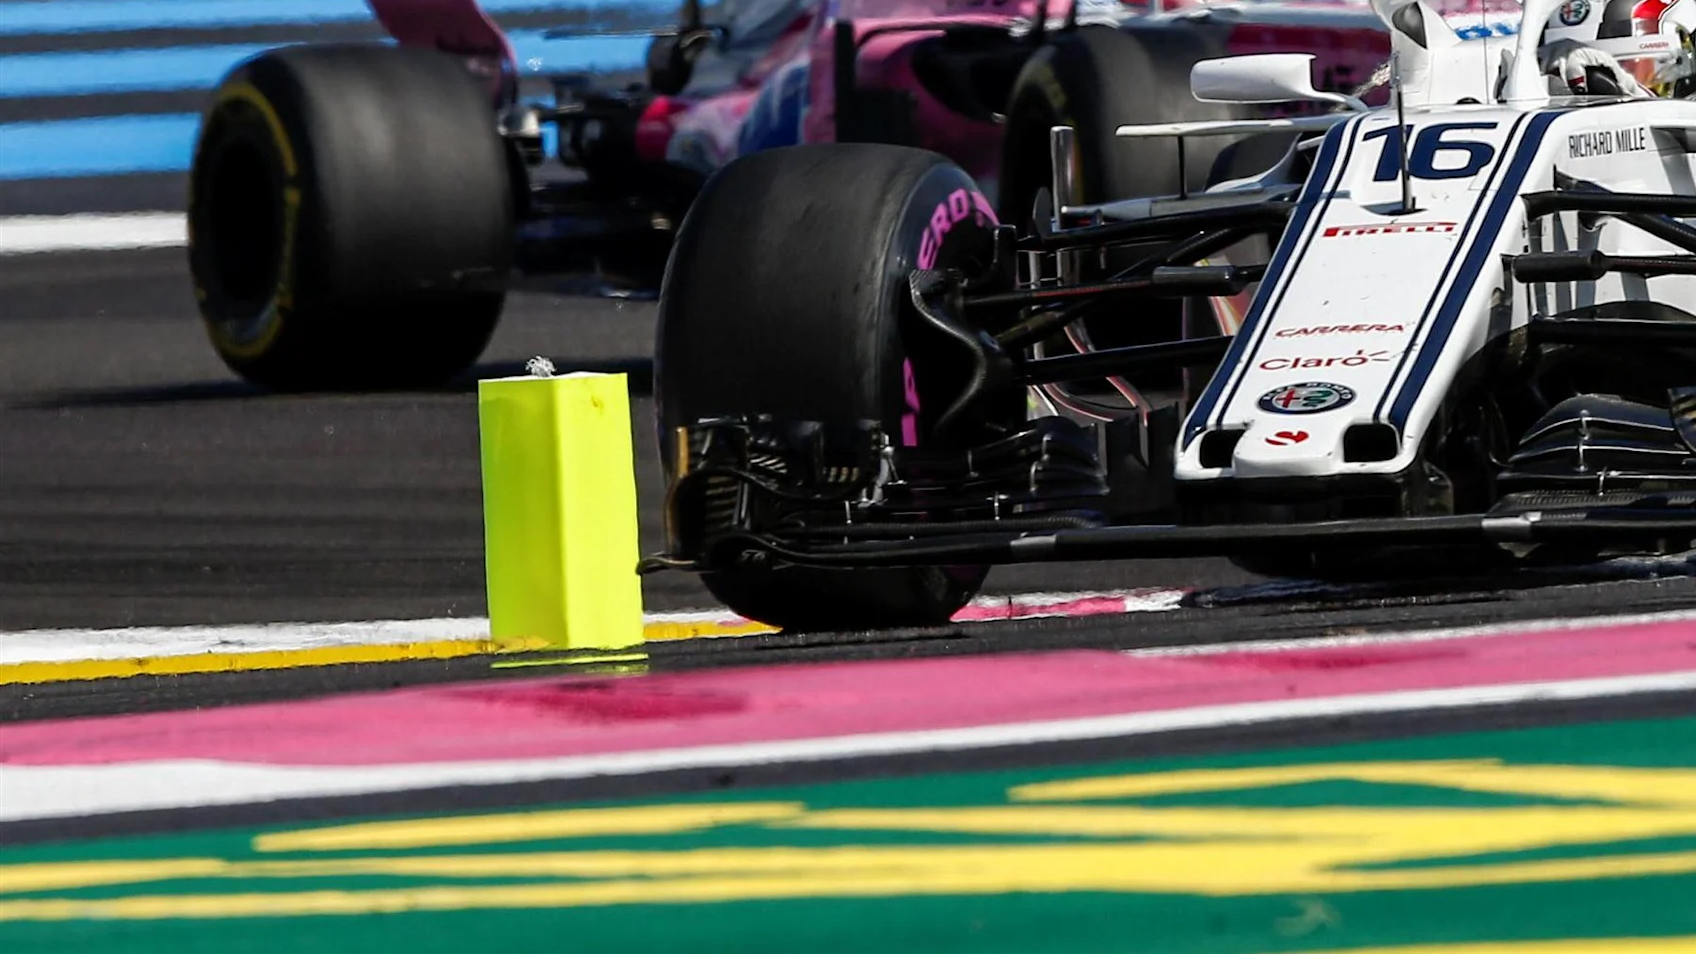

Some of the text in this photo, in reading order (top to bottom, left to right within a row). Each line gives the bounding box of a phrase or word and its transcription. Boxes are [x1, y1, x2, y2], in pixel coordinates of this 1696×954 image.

[1362, 122, 1498, 182] 16
[1569, 128, 1646, 158] RICHARD MILLE
[917, 188, 970, 270] ERO
[1323, 222, 1457, 238] PIRELLI
[1275, 324, 1404, 337] CARRERA
[1259, 350, 1370, 371] Claro
